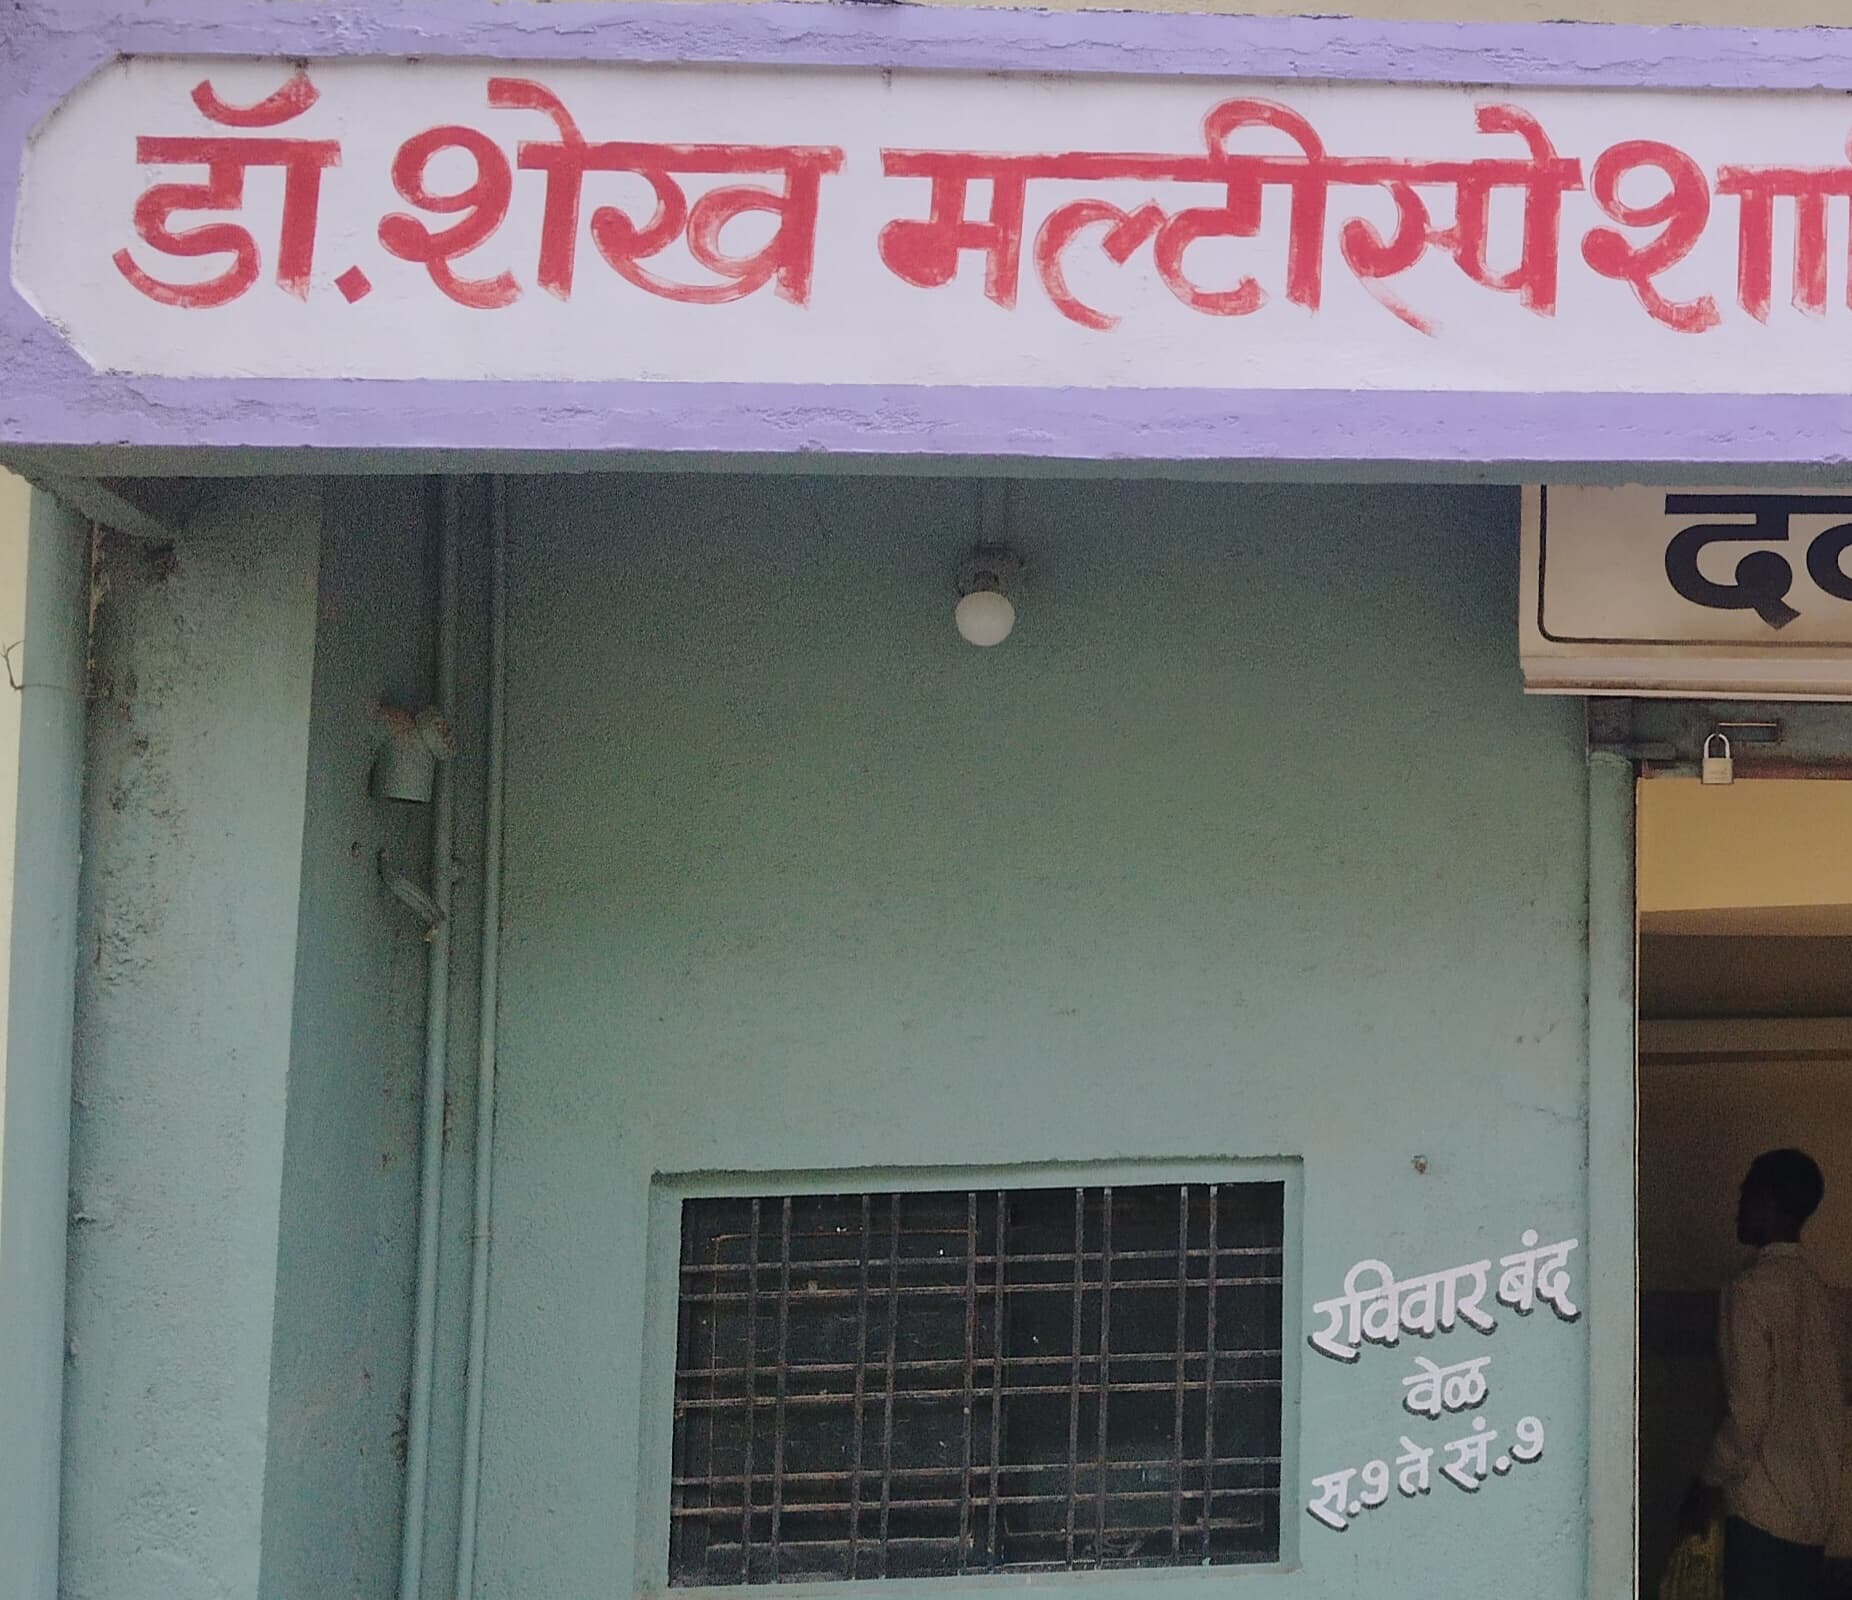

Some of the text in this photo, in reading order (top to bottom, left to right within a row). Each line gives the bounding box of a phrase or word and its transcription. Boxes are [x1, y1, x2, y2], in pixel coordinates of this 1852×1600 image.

[1308, 1229, 1582, 1363] रविवार बंद
[1402, 1356, 1491, 1419] वेळ
[1396, 1436, 1434, 1497] ते
